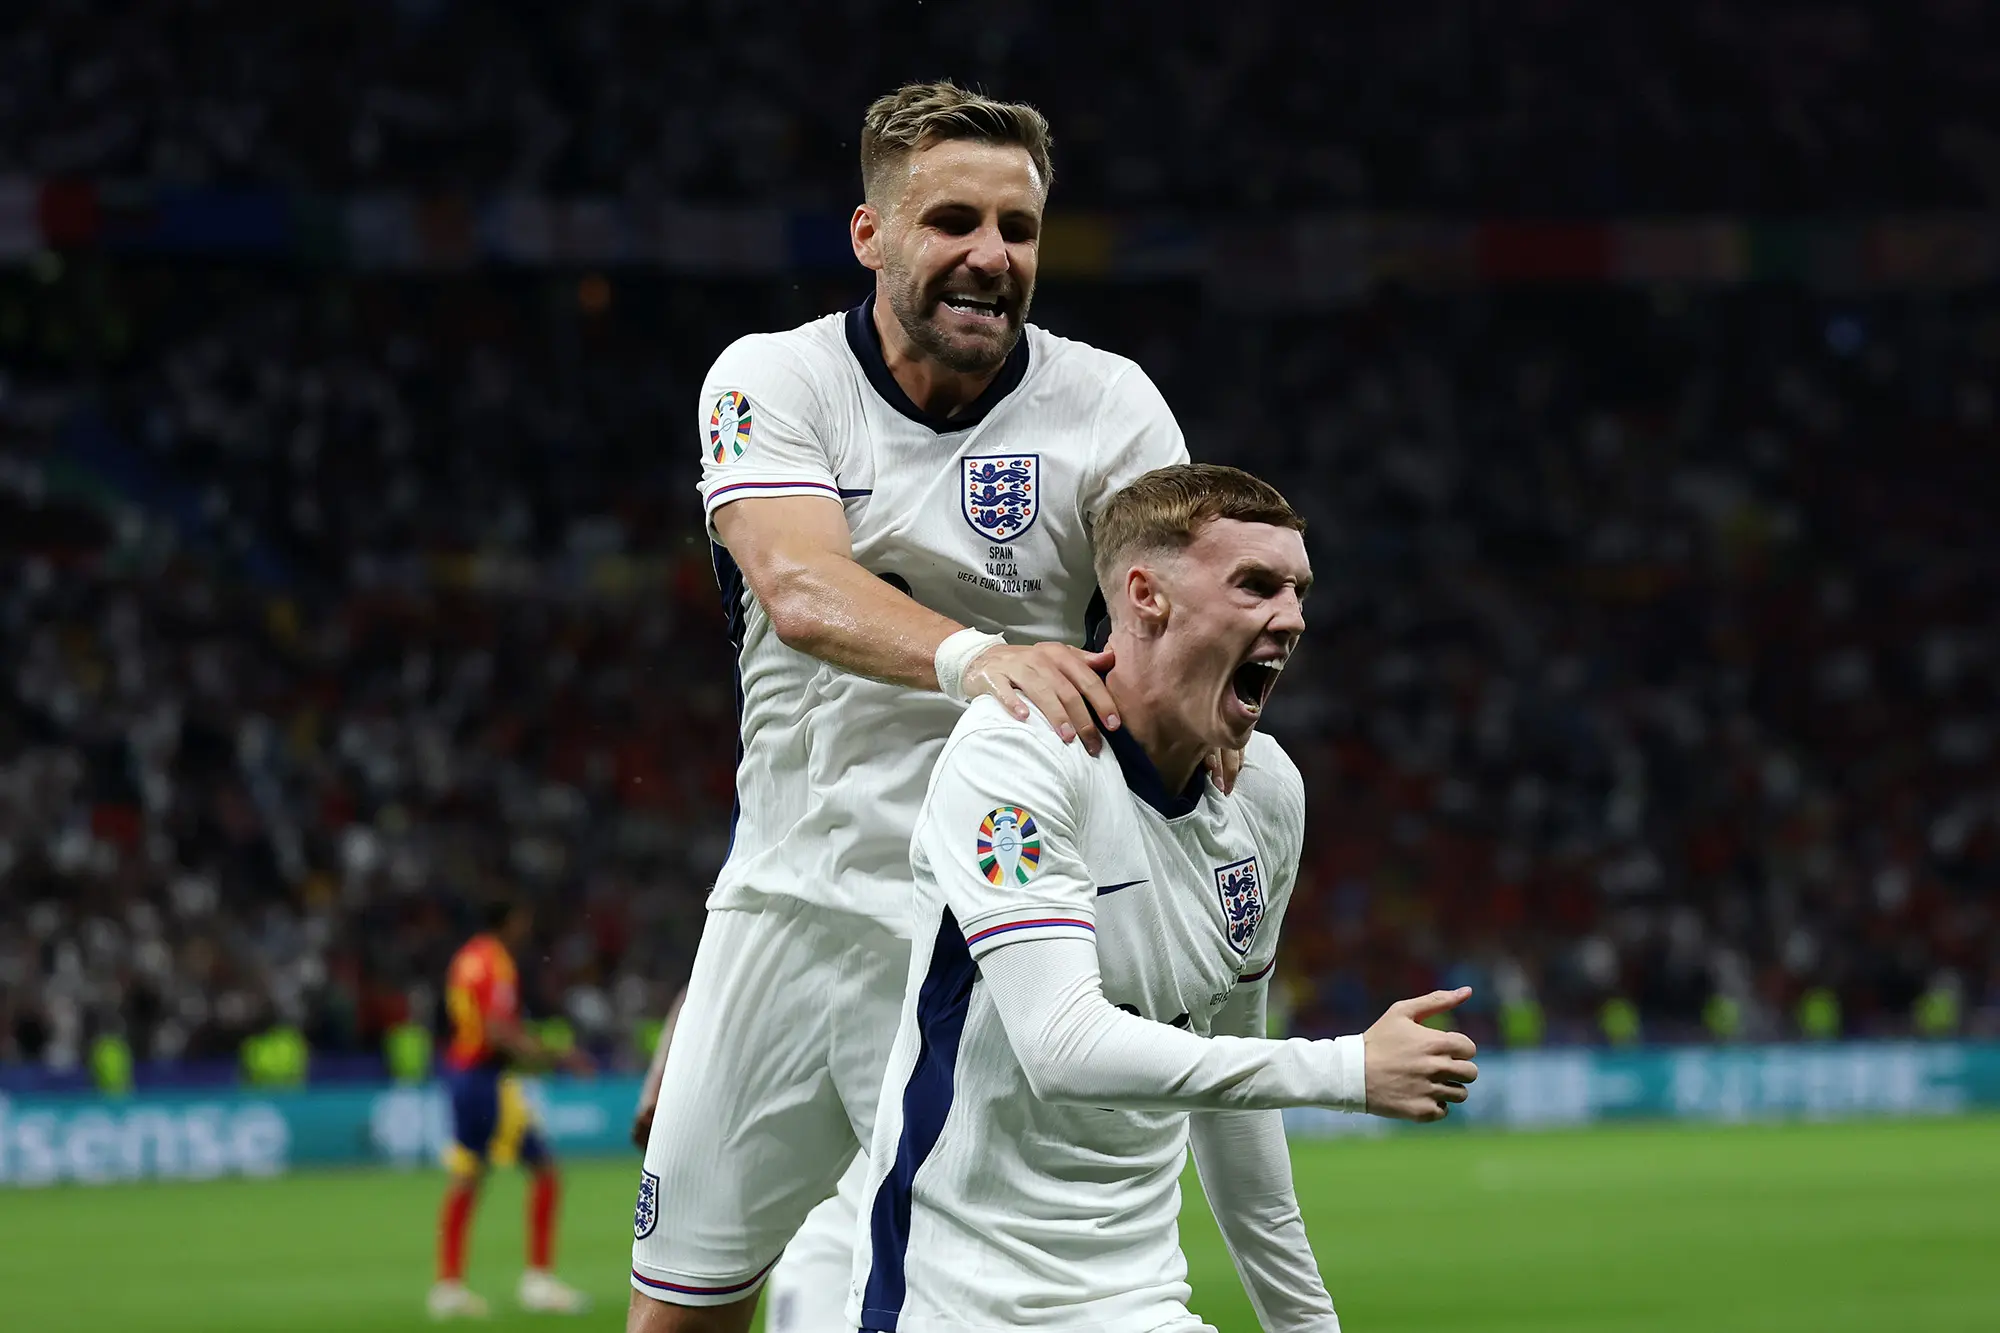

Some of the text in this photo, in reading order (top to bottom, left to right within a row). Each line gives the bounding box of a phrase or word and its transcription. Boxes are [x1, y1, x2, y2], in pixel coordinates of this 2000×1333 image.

[989, 546, 1013, 560] SPAIN
[985, 563, 1018, 577] 14.07.24
[957, 571, 1042, 593] UEFA EURO 2024 FINAL
